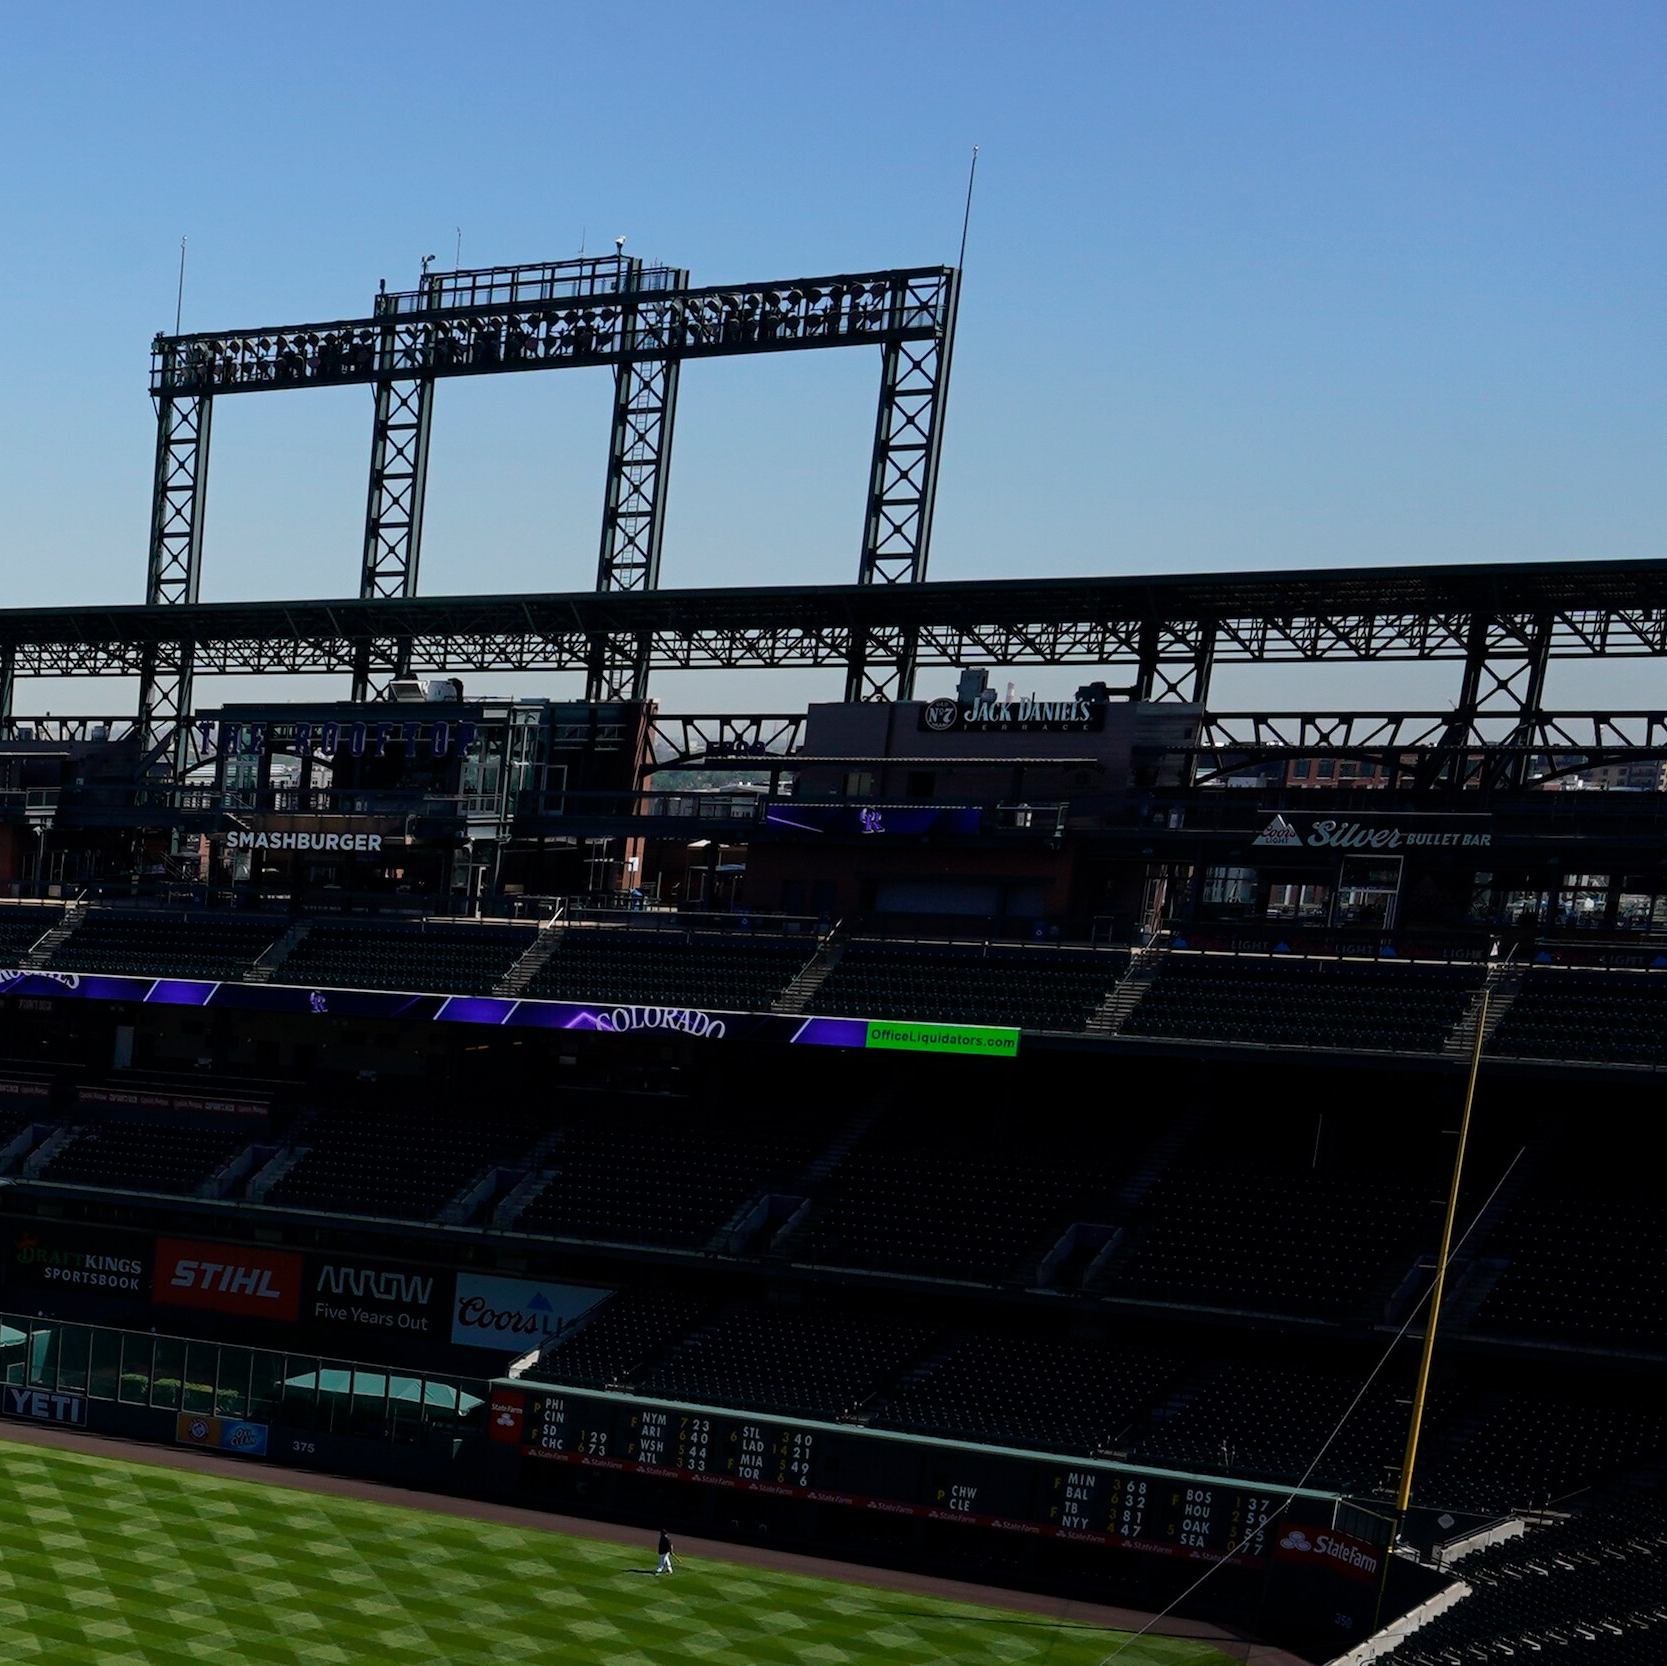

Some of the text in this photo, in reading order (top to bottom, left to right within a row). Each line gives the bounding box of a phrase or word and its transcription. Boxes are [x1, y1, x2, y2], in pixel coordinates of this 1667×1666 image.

[964, 697, 1012, 722] JACK
[199, 721, 479, 758] THE ROOFTOP
[226, 831, 383, 851] SMASHBURGER
[1307, 819, 1492, 848] Silver BULLET BAR
[595, 1007, 727, 1039] COLORADO
[870, 1028, 1016, 1050] OfficeLiquidators.com
[44, 1266, 140, 1291] SPORTSBOOK
[170, 1259, 281, 1299] STIHL
[317, 1264, 435, 1305] ARROW
[314, 1302, 429, 1332] Five Years Out
[458, 1296, 539, 1335] Coors
[9, 1388, 81, 1424] YETI
[545, 1397, 565, 1411] PHI
[543, 1410, 565, 1424] CIN
[642, 1411, 667, 1426] NYM
[542, 1423, 557, 1436] SD
[641, 1426, 662, 1438] ARI
[742, 1426, 762, 1440] STL
[292, 1440, 315, 1454] 375
[541, 1437, 564, 1451] CHC
[640, 1439, 665, 1453] WSH
[742, 1439, 765, 1453] LAD
[637, 1452, 658, 1465] ATL
[739, 1453, 764, 1468] MIA
[738, 1466, 808, 1487] TOR 6
[1068, 1472, 1096, 1488] MIN
[951, 1484, 978, 1499] CHW
[1066, 1487, 1089, 1501] BAL
[1186, 1488, 1212, 1504] BOS
[949, 1498, 971, 1512] CLE
[1064, 1501, 1079, 1514] TB
[1184, 1503, 1211, 1518] HOU
[1062, 1515, 1090, 1530] NYY
[1182, 1519, 1210, 1535] OAK
[1179, 1533, 1205, 1549] SEA
[1334, 1612, 1352, 1630] 350
